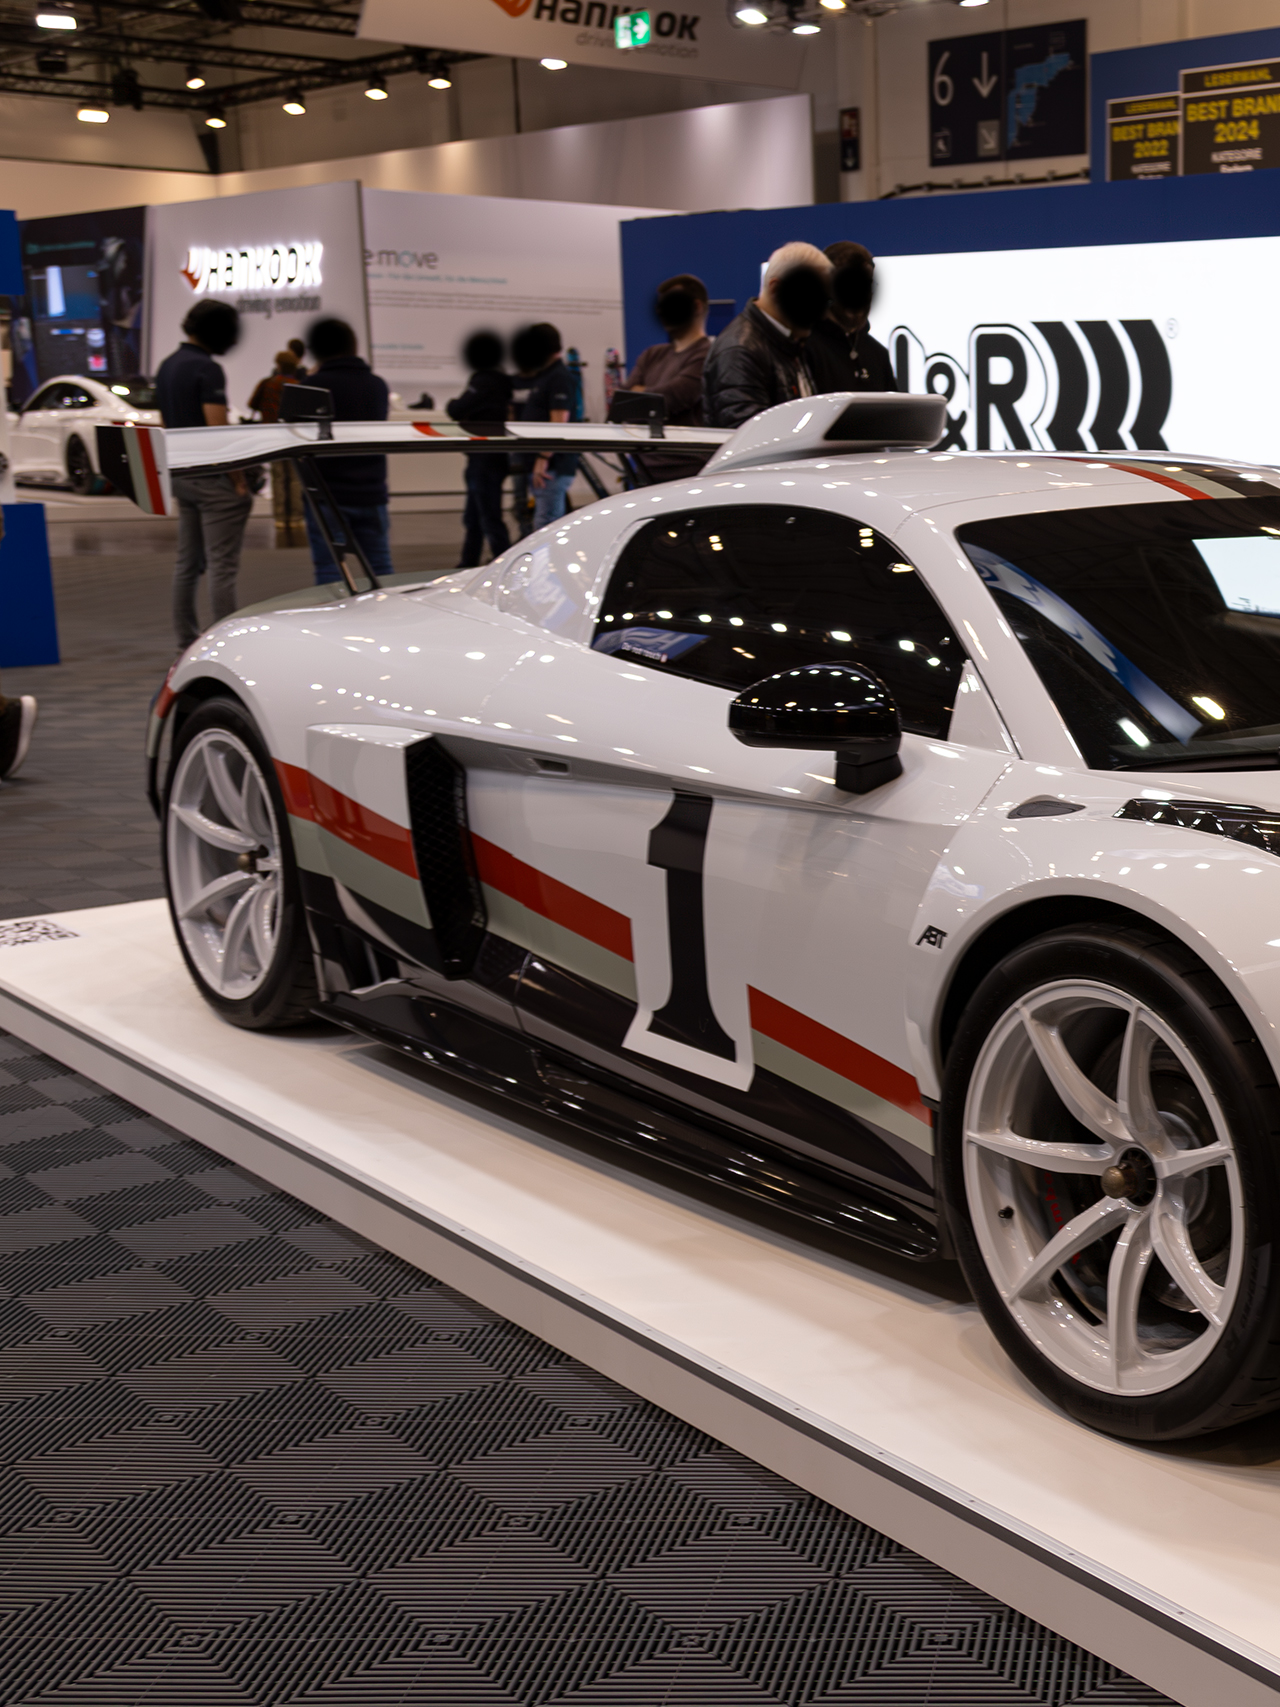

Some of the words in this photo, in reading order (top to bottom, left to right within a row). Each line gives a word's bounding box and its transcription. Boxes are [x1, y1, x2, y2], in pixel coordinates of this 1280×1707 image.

[934, 51, 954, 107] 6
[1186, 100, 1229, 122] BEST
[1112, 124, 1144, 142] BEST
[1147, 121, 1180, 138] BRAN
[1213, 119, 1260, 143] 2024
[646, 787, 738, 1064] 1
[915, 924, 949, 950] ABT
